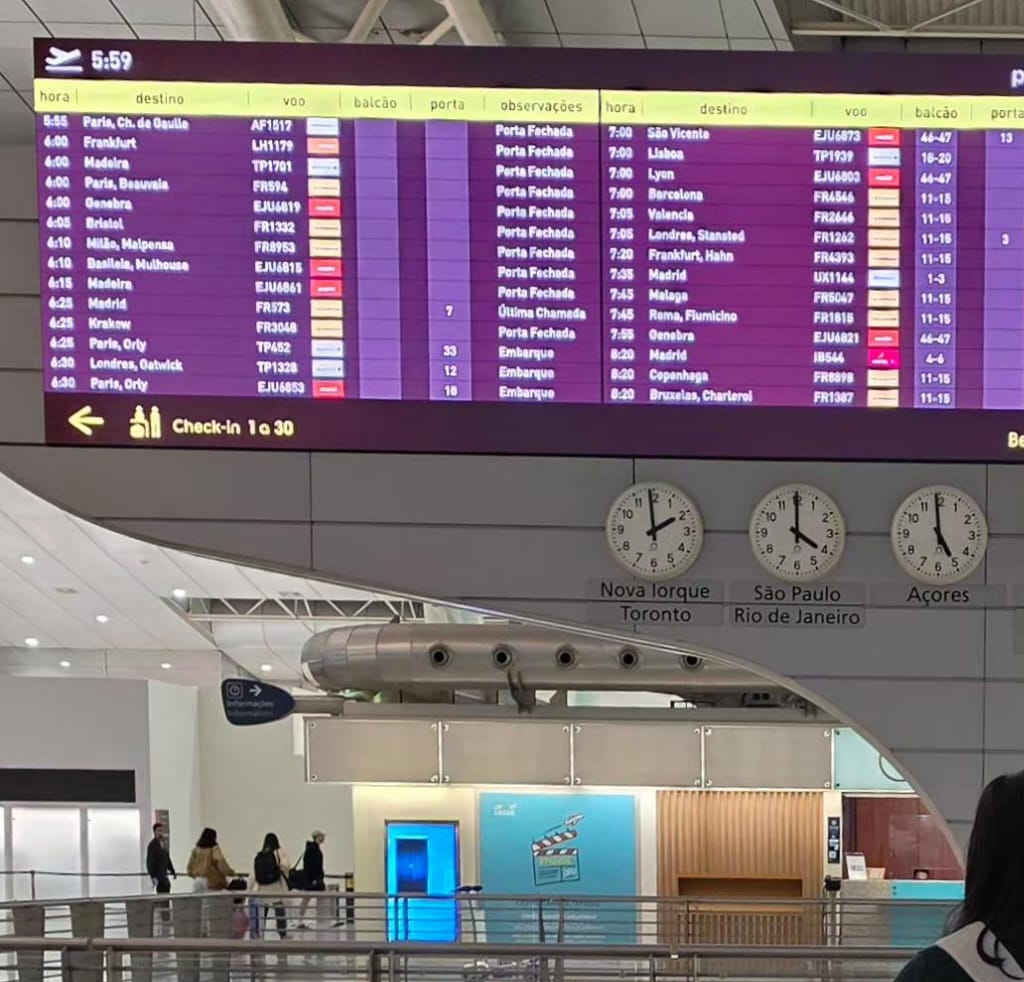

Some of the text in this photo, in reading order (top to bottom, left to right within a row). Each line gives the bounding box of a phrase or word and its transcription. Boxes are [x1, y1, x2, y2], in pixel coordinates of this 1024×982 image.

[92, 51, 131, 69] 5:59
[40, 91, 582, 112] hora destino voo balcão porta observações
[607, 103, 635, 113] hora
[701, 104, 747, 115] destino
[916, 107, 957, 118] balcão
[992, 109, 1024, 120] porta
[44, 115, 573, 136] 5:55 Paris, Ch. de Gaulle AF1517 Porta Fechada
[609, 126, 632, 138] 7:00
[648, 128, 668, 138] São
[670, 128, 709, 138] Vicente
[1001, 133, 1012, 143] 13
[44, 135, 293, 151] 6:00 Frankfurt LH1179
[648, 147, 853, 162] Lisboa TP1939
[648, 208, 694, 221] Valencia
[610, 248, 734, 261] 7:20 Frankfurt, Hahn
[928, 274, 945, 284] 1-3
[49, 297, 586, 319] 6:25 Madrid FR573 7 Última Chamada
[649, 310, 737, 321] Roma, Fiumicino
[89, 318, 131, 330] Krakow
[51, 357, 554, 381] 6:30 Londres, Gatwick 12 Embarque
[173, 419, 293, 435] Check-in 1 a 30
[601, 582, 712, 603] Nova Iorque
[752, 585, 840, 604] São Paulo
[907, 587, 969, 606] Açores
[621, 606, 691, 621] Toronto
[735, 608, 859, 624] Rio de Janeiro
